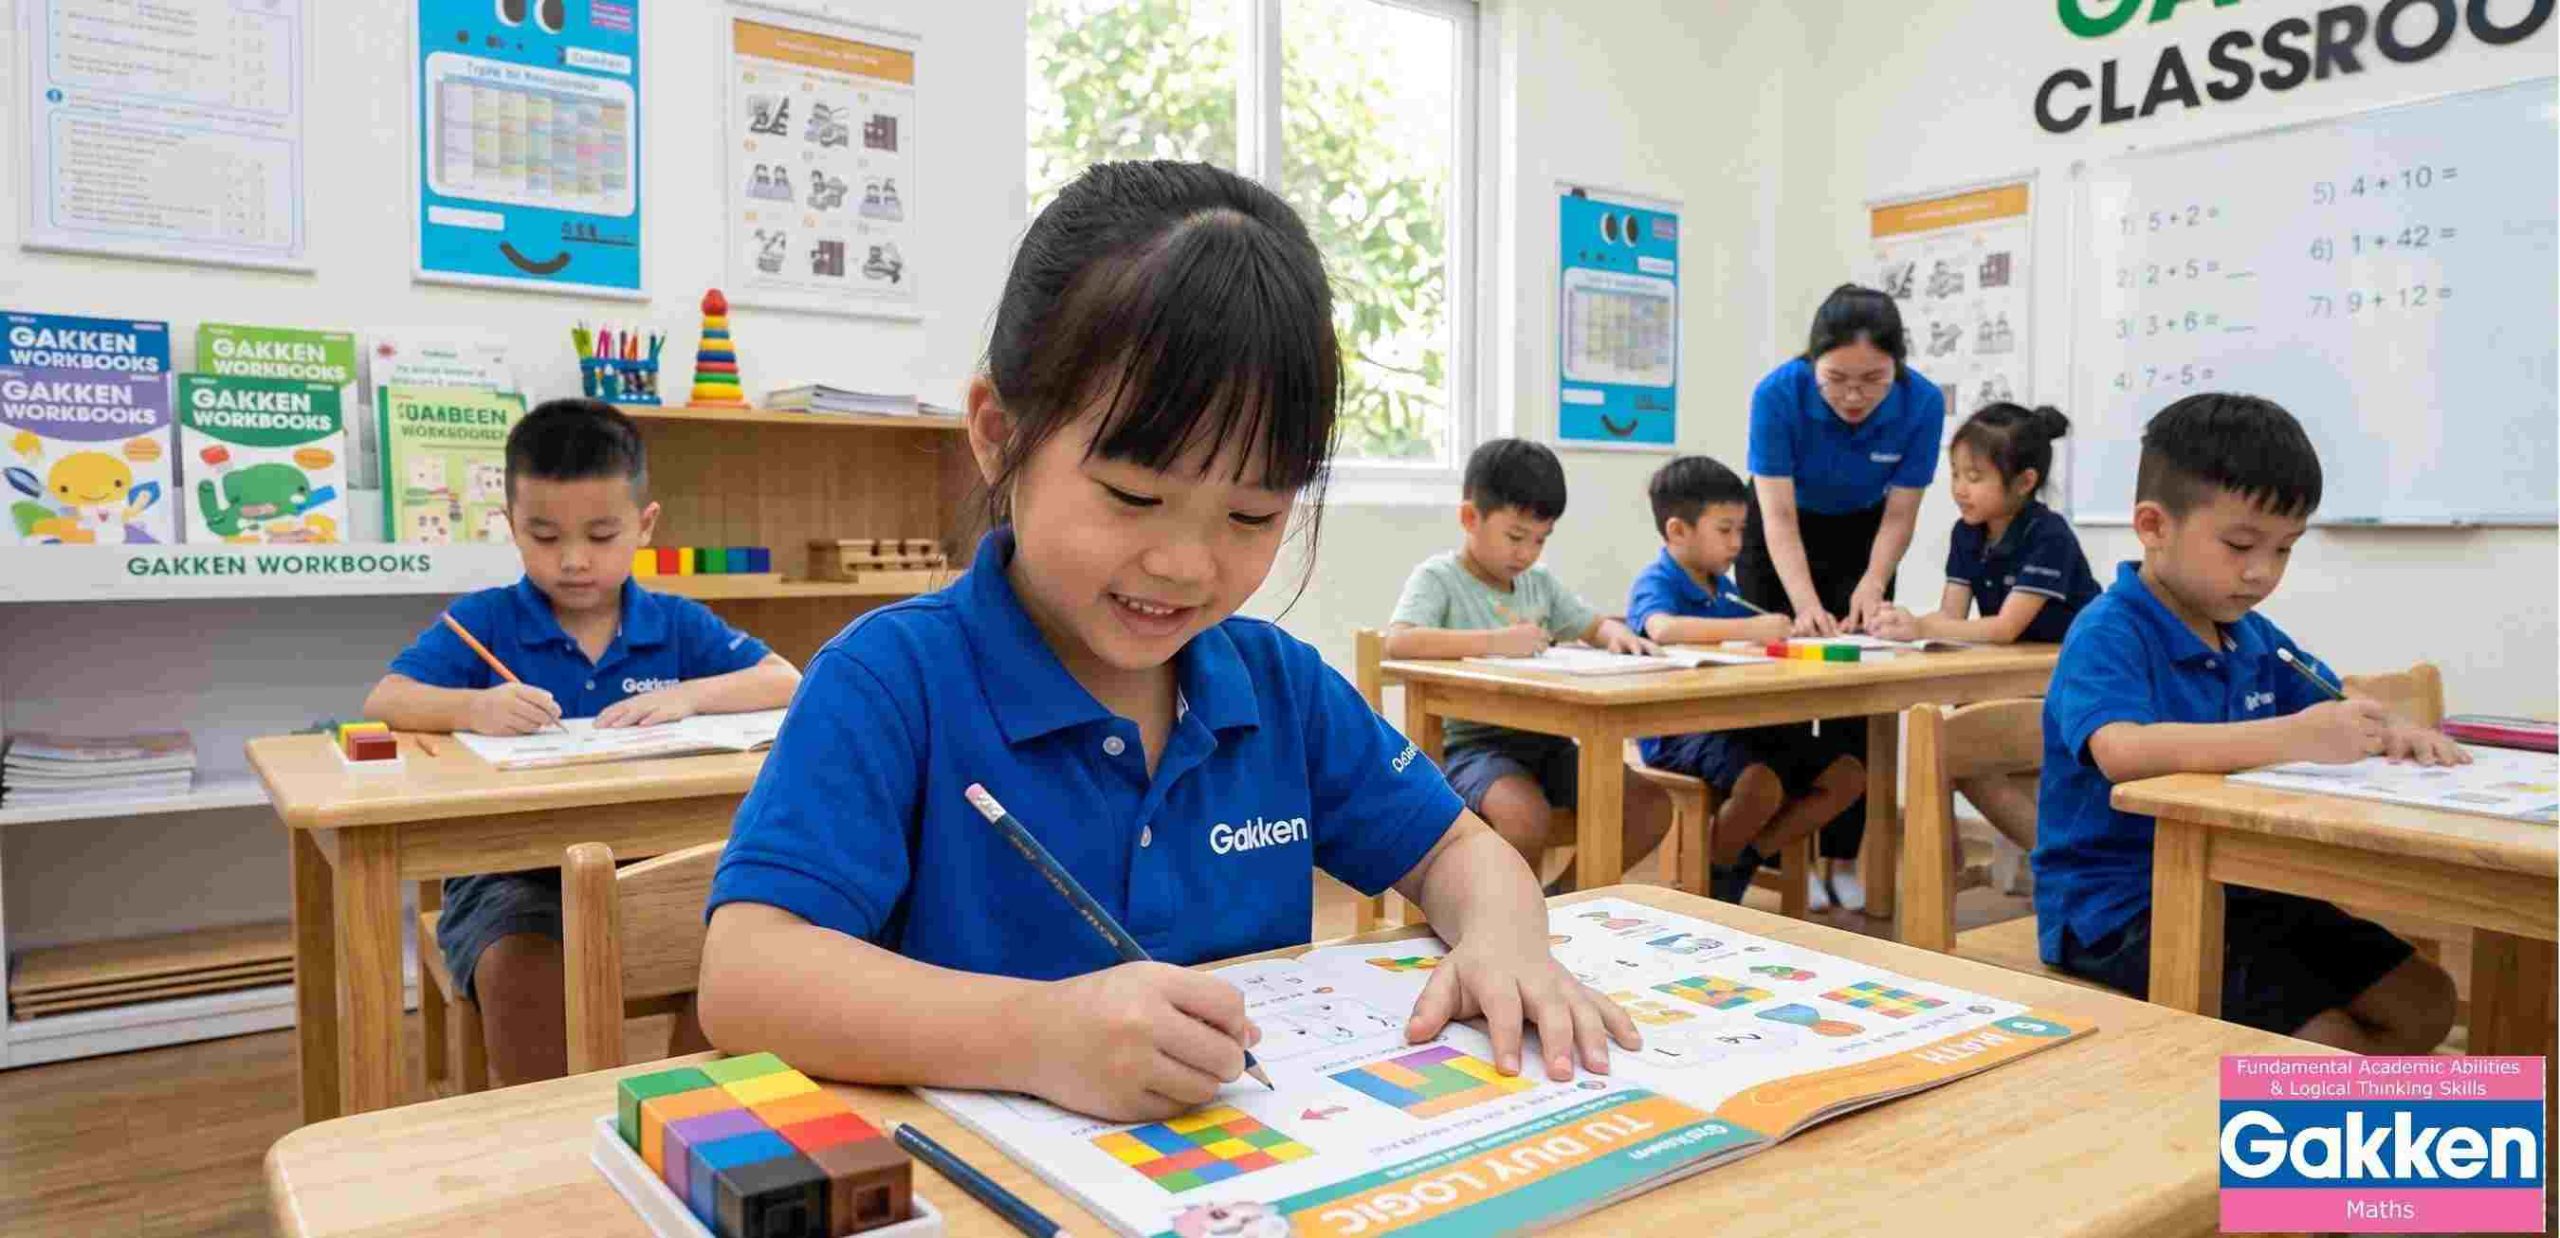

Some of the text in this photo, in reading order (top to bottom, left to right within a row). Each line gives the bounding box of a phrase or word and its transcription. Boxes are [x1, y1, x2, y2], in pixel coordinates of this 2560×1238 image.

[2034, 0, 2556, 134] CLASSROO
[2351, 176, 2365, 197] 4
[2402, 165, 2432, 188] 10
[2149, 212, 2160, 231] 5
[2186, 205, 2200, 226] 2
[2352, 234, 2361, 256] 1
[2397, 225, 2430, 247] 42
[2147, 265, 2159, 285] 2
[2186, 259, 2199, 279] 5
[2348, 292, 2362, 313] 9
[2399, 284, 2428, 307] 12
[2184, 311, 2198, 332] 6
[9, 326, 137, 354] GAKKEN
[212, 338, 326, 363] GAKKEN
[9, 349, 159, 372] WORKBOOKS
[212, 358, 347, 381] WORKBOOKS
[2146, 367, 2157, 387] 7
[2181, 364, 2194, 385] 5
[2, 380, 133, 405] GAKKEN
[191, 387, 311, 413] GAKKEN
[2, 402, 157, 425] WORKBOOKS
[192, 409, 332, 431] WORKBOOKS
[127, 553, 431, 576] GAKKEN WORKBOOKS
[1209, 816, 1308, 855] Gakken
[1584, 1113, 1654, 1143] TU
[1485, 1137, 1590, 1182] DUY
[1320, 1170, 1487, 1235] LOGIC
